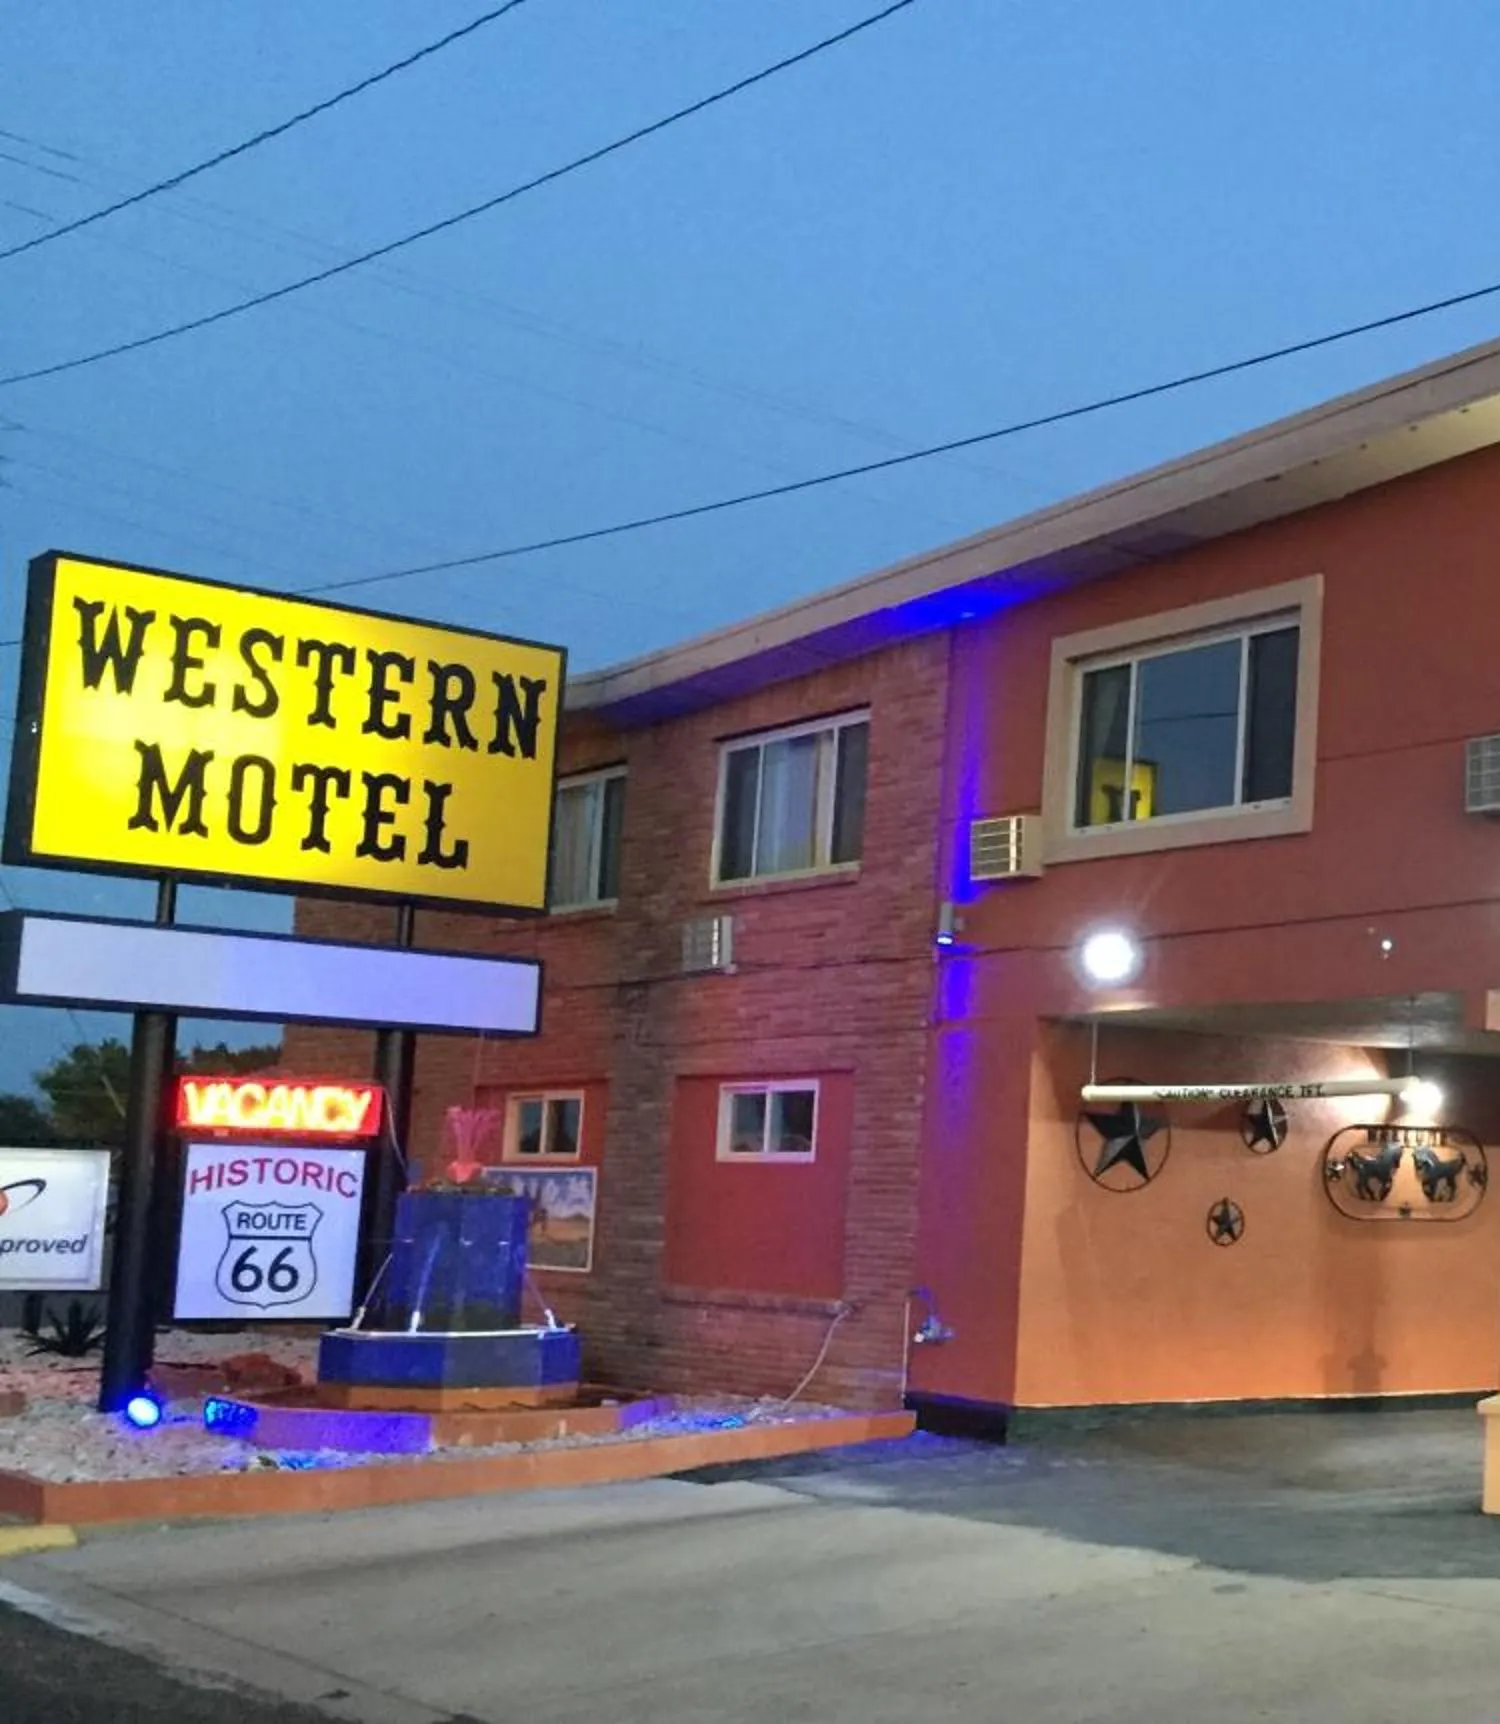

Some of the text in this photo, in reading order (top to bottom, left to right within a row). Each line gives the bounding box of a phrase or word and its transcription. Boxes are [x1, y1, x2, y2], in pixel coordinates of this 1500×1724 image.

[73, 595, 548, 759] WESTERN
[127, 739, 470, 870] MOTEL
[183, 1080, 373, 1132] VACANCY
[1219, 1085, 1294, 1099] CLEARANCE
[189, 1157, 358, 1198] HISTORIC
[237, 1212, 307, 1230] ROUTE
[231, 1246, 299, 1292] 66
